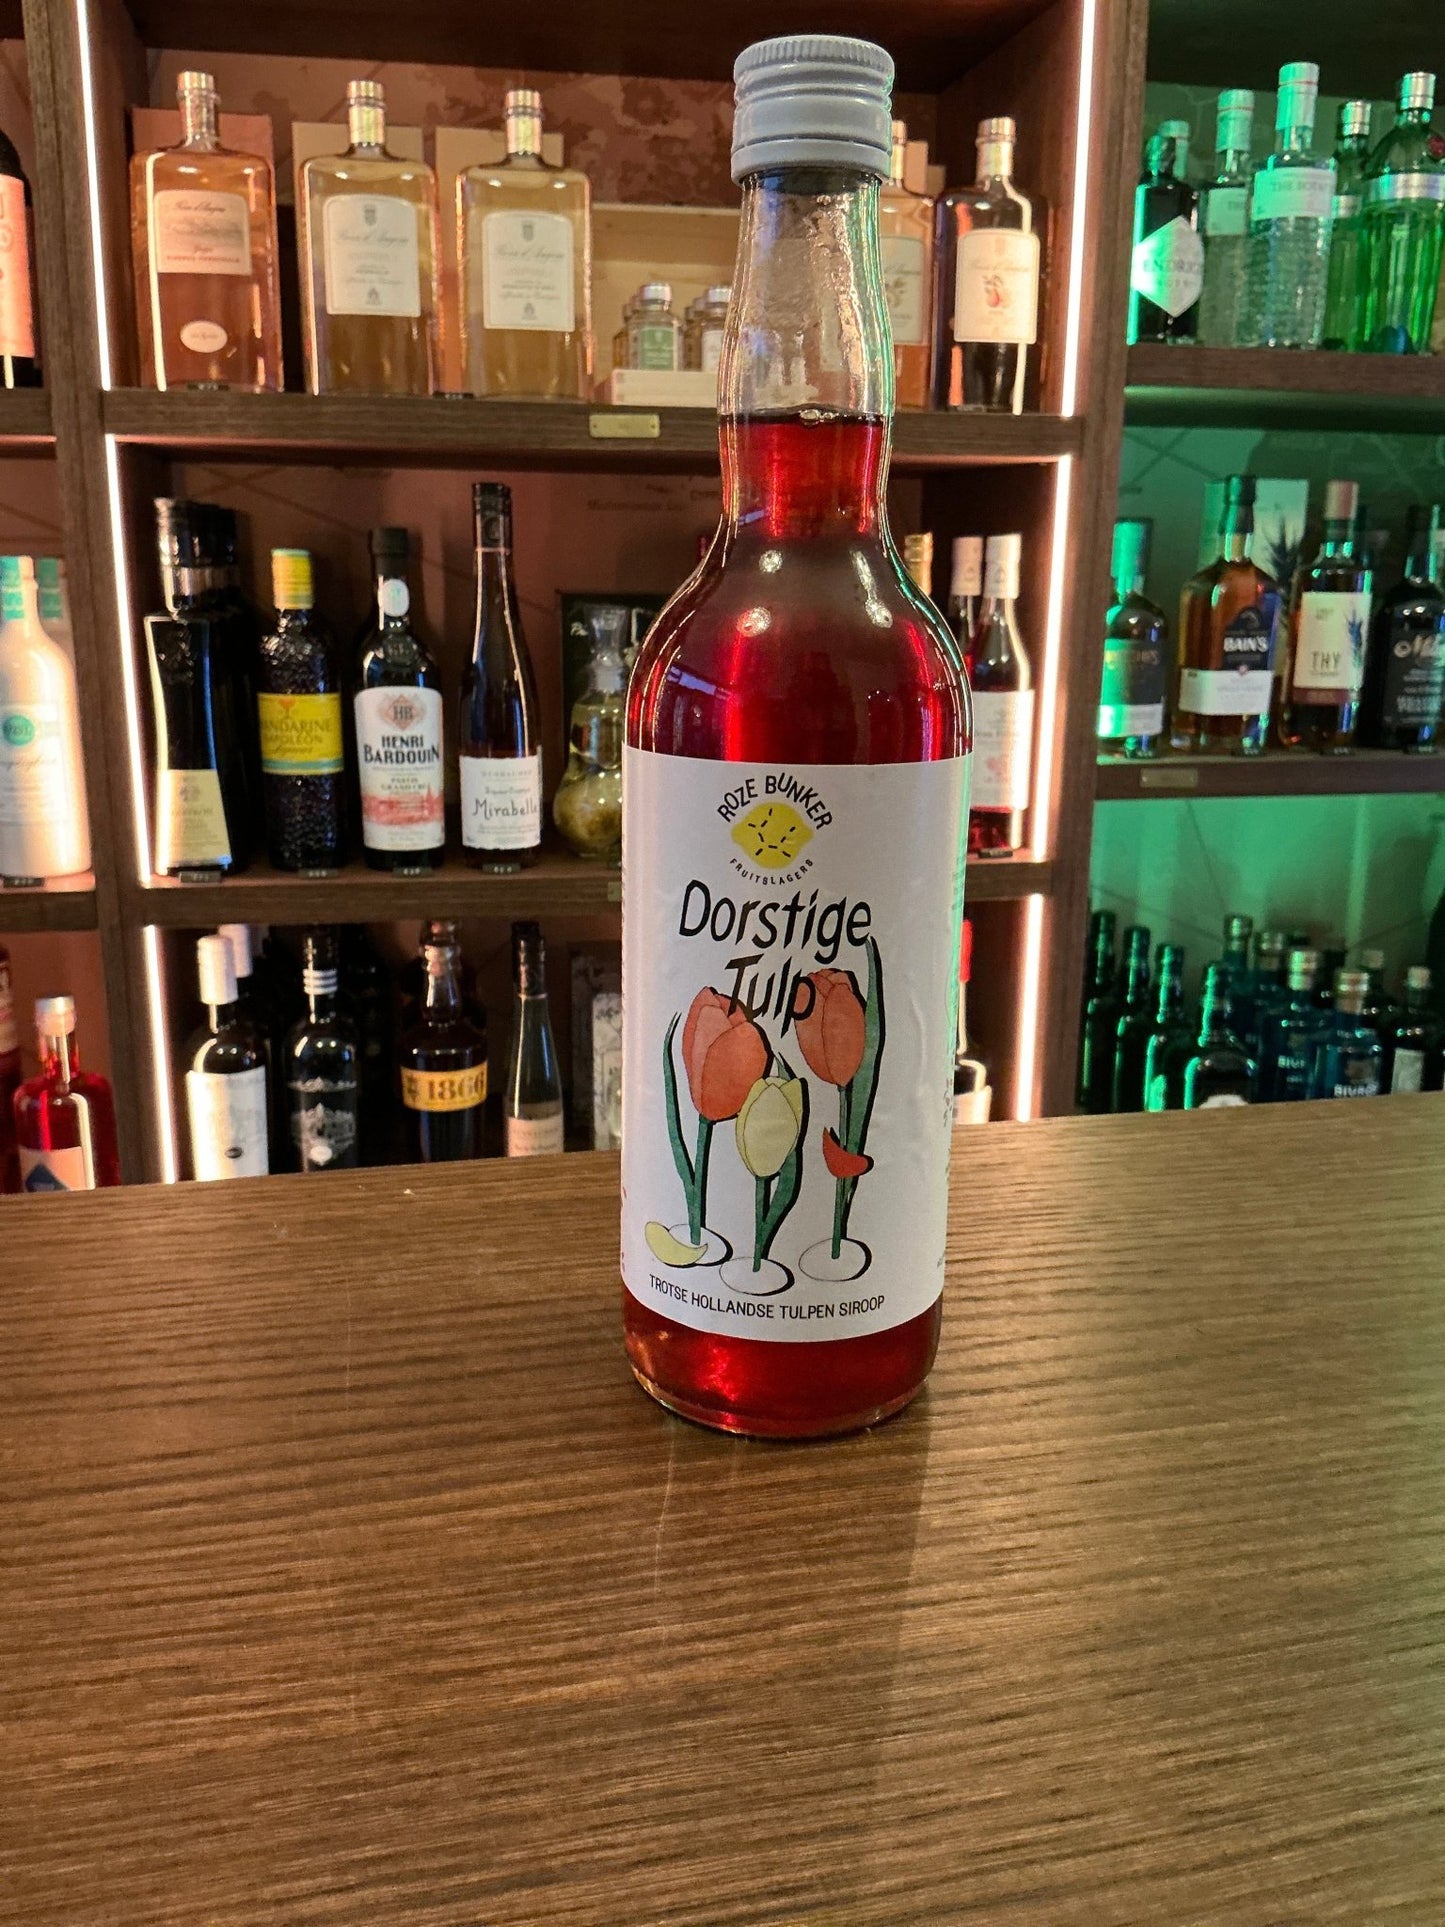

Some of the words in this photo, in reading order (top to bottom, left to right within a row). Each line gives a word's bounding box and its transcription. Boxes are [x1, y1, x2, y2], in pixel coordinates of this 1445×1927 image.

[1223, 636, 1269, 653] BAIN'S
[1311, 651, 1341, 672] THY
[393, 705, 414, 721] HB
[363, 743, 440, 765] BARDOUIN
[381, 735, 425, 749] HENRI
[716, 778, 759, 823] ROZE
[764, 772, 833, 831] BUNKER
[729, 857, 814, 886] FRUITSLAGERS
[679, 879, 872, 965] Dorstige
[724, 952, 817, 1039] Tulp
[427, 1070, 486, 1101] 1866
[649, 1273, 689, 1303] TROTSE
[691, 1291, 775, 1319] HOLLANDSE
[779, 1303, 835, 1320] TULPEN
[839, 1295, 885, 1317] SIROOP
